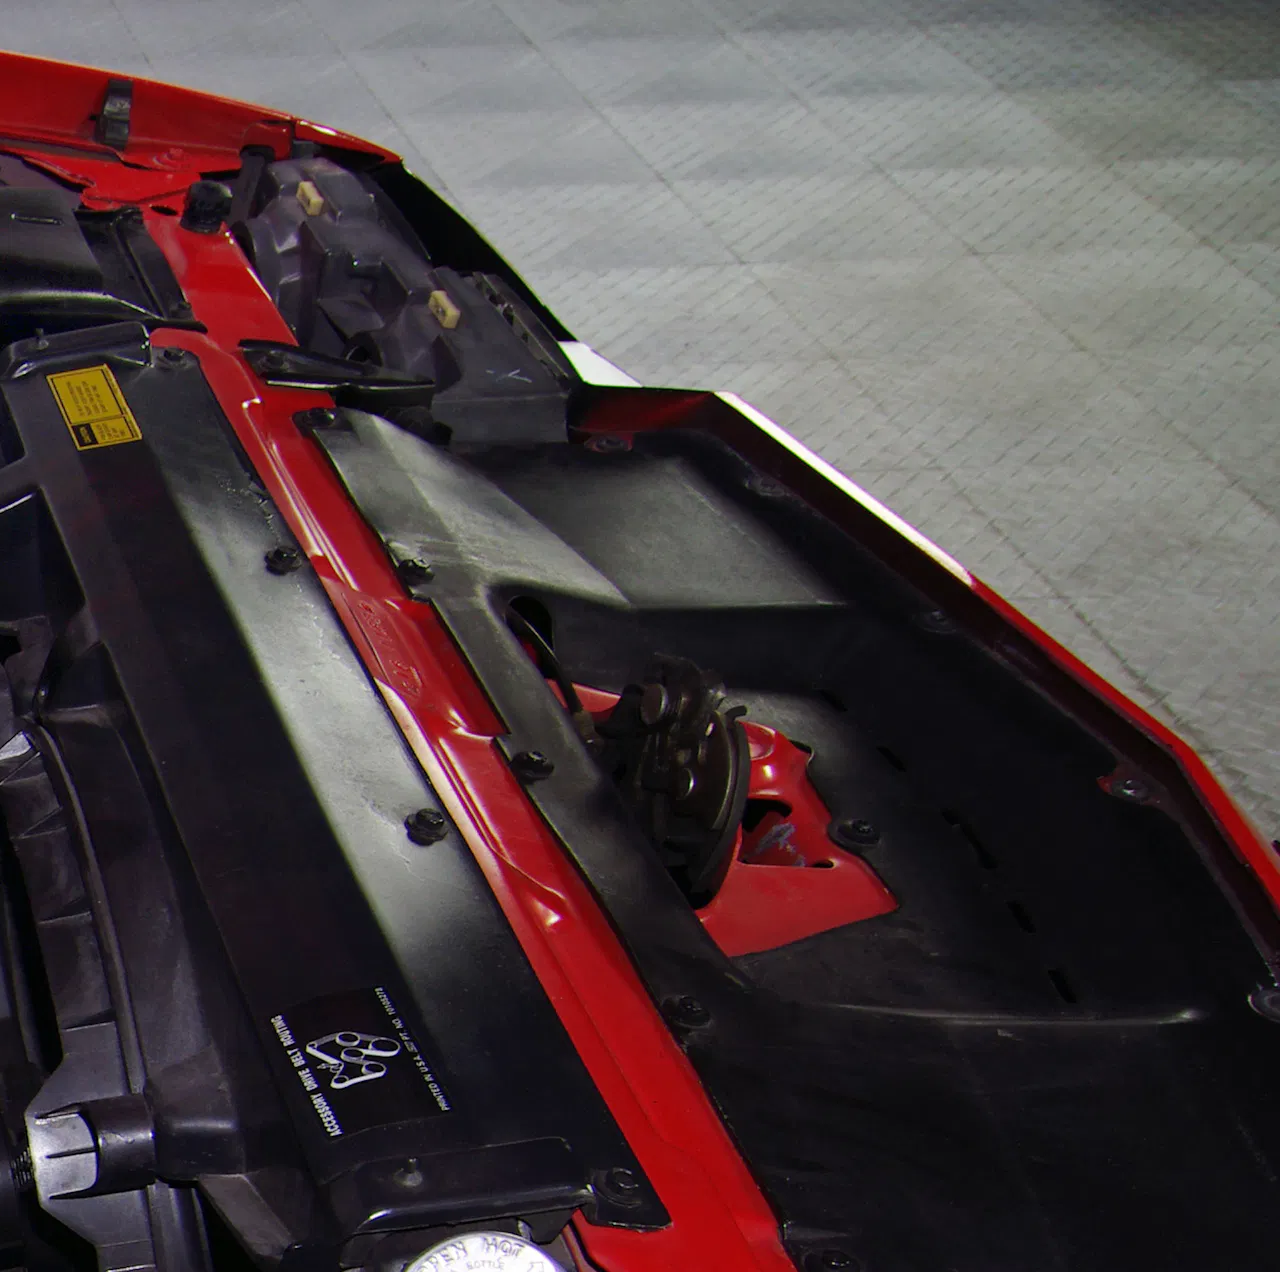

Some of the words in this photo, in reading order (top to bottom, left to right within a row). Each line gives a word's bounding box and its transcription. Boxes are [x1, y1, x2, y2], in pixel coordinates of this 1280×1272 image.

[270, 1013, 294, 1047] ROUTING
[286, 1045, 305, 1067] BELT
[297, 1066, 318, 1092] DRIVE
[423, 1072, 433, 1083] IN
[428, 1081, 450, 1112] PRINTED
[309, 1090, 342, 1138] ACCESSORY
[482, 1236, 525, 1257] HOT
